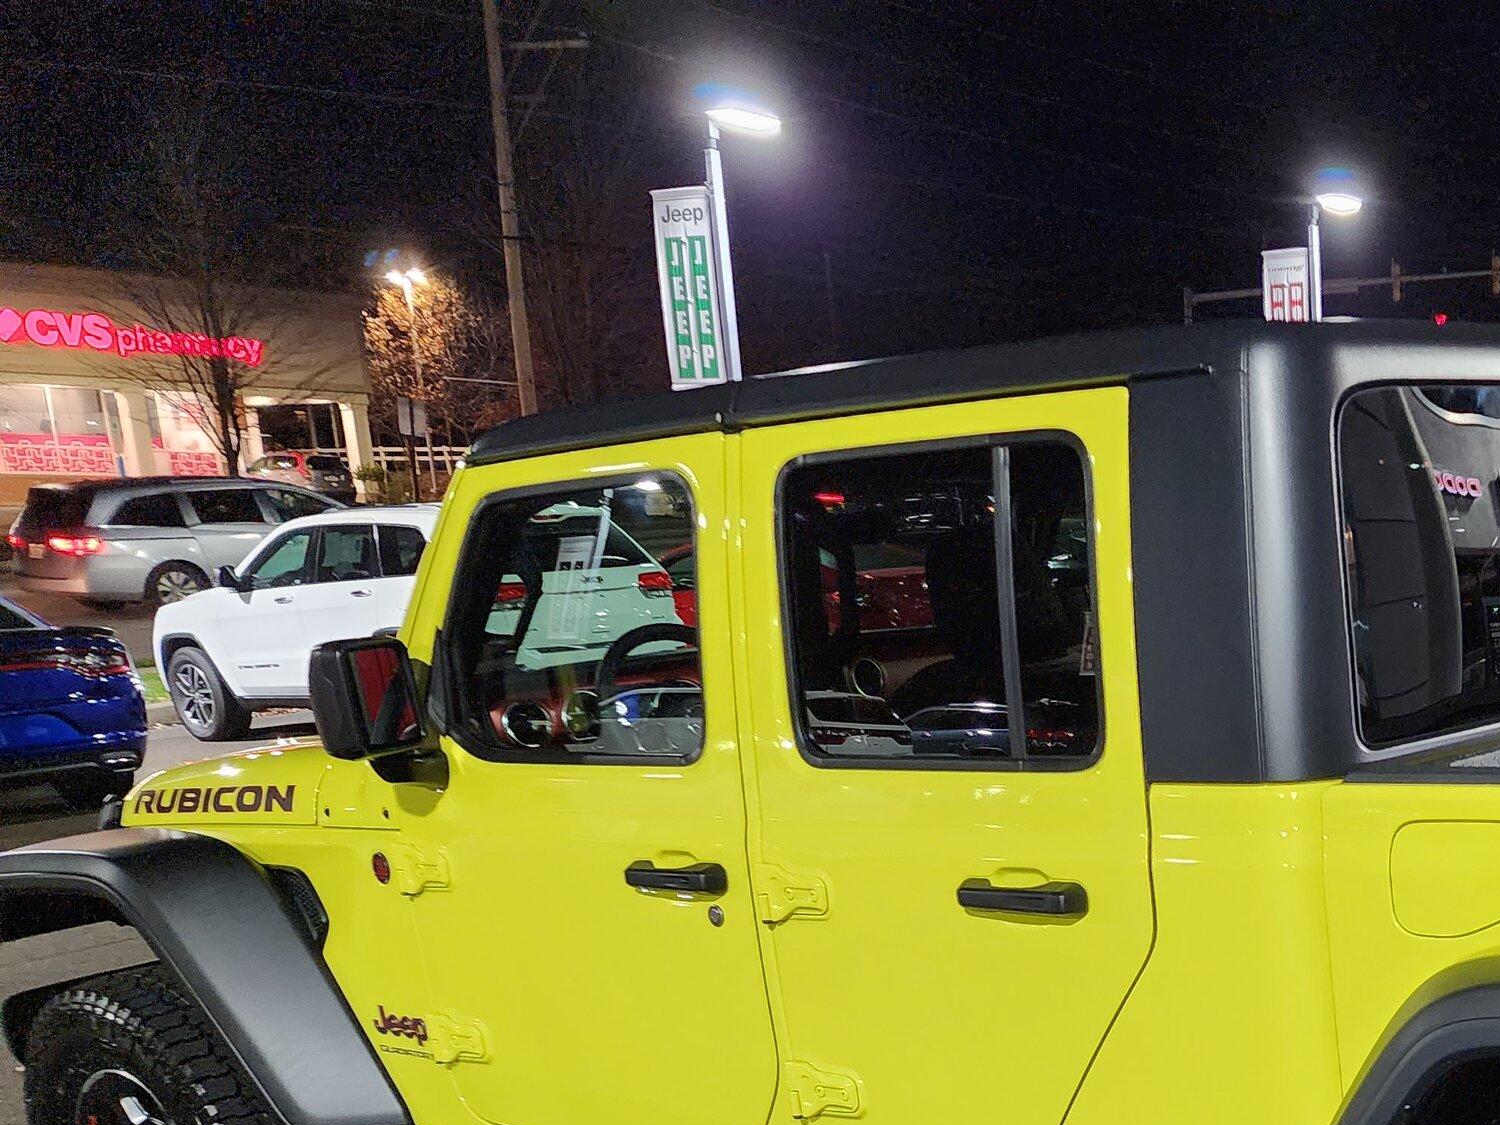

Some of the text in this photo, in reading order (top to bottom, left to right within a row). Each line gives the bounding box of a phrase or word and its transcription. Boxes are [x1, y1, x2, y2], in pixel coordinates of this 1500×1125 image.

[661, 205, 703, 225] Jeep
[25, 310, 113, 349] CVS
[134, 785, 296, 814] RUBICON
[373, 1004, 428, 1047] Jeep
